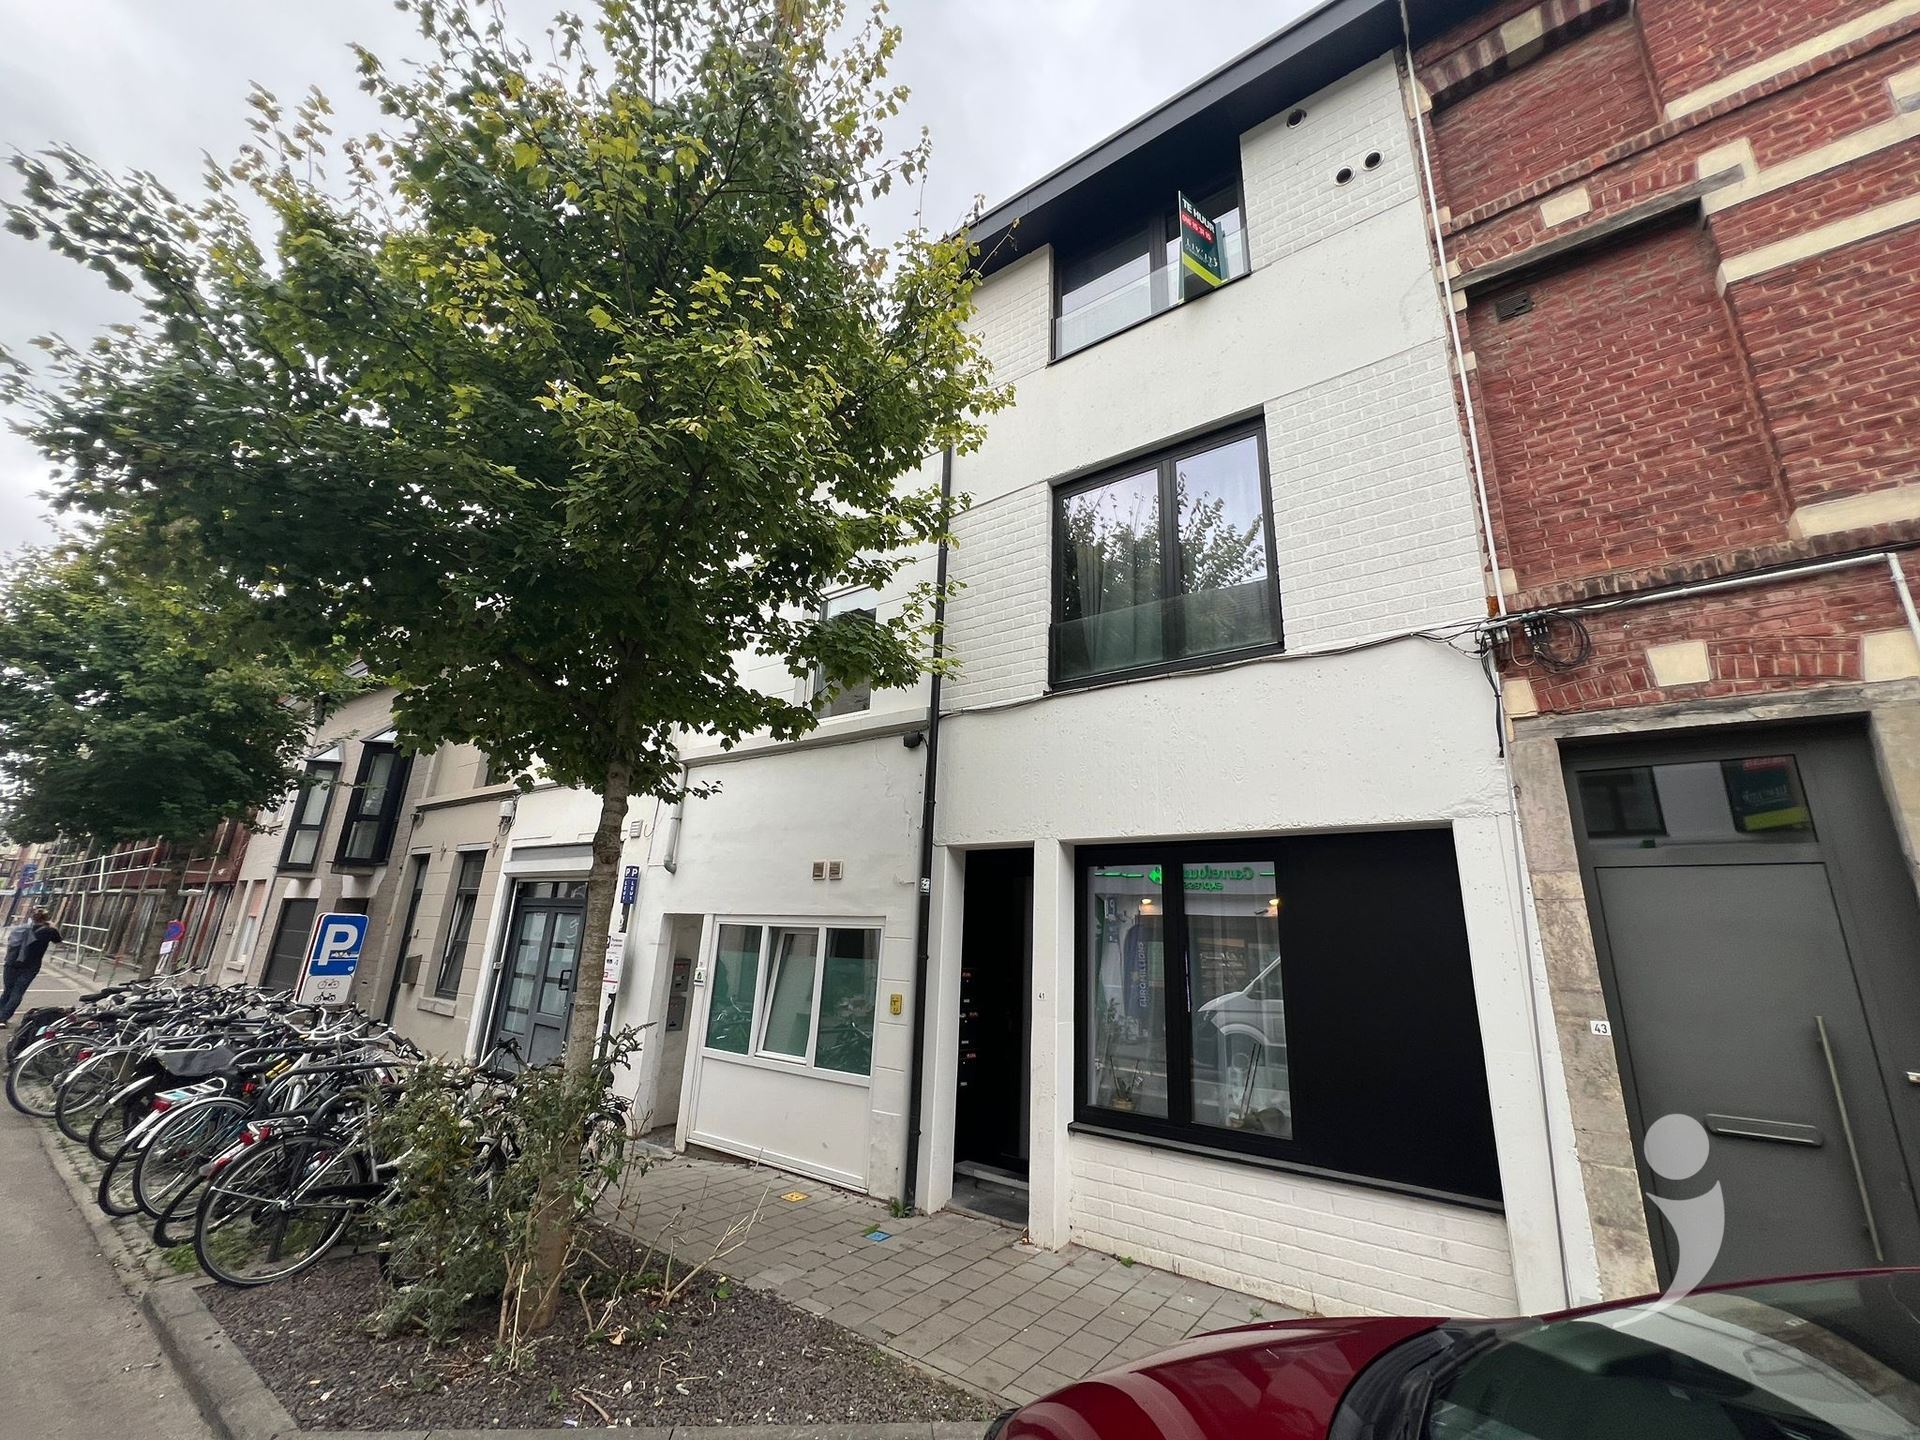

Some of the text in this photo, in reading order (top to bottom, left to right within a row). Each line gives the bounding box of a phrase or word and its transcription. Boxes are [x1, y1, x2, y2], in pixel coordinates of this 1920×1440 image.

[1182, 198, 1193, 214] TE
[1193, 208, 1215, 233] HUUR
[631, 868, 638, 876] P
[317, 923, 358, 966] P
[1594, 1023, 1607, 1034] 43
